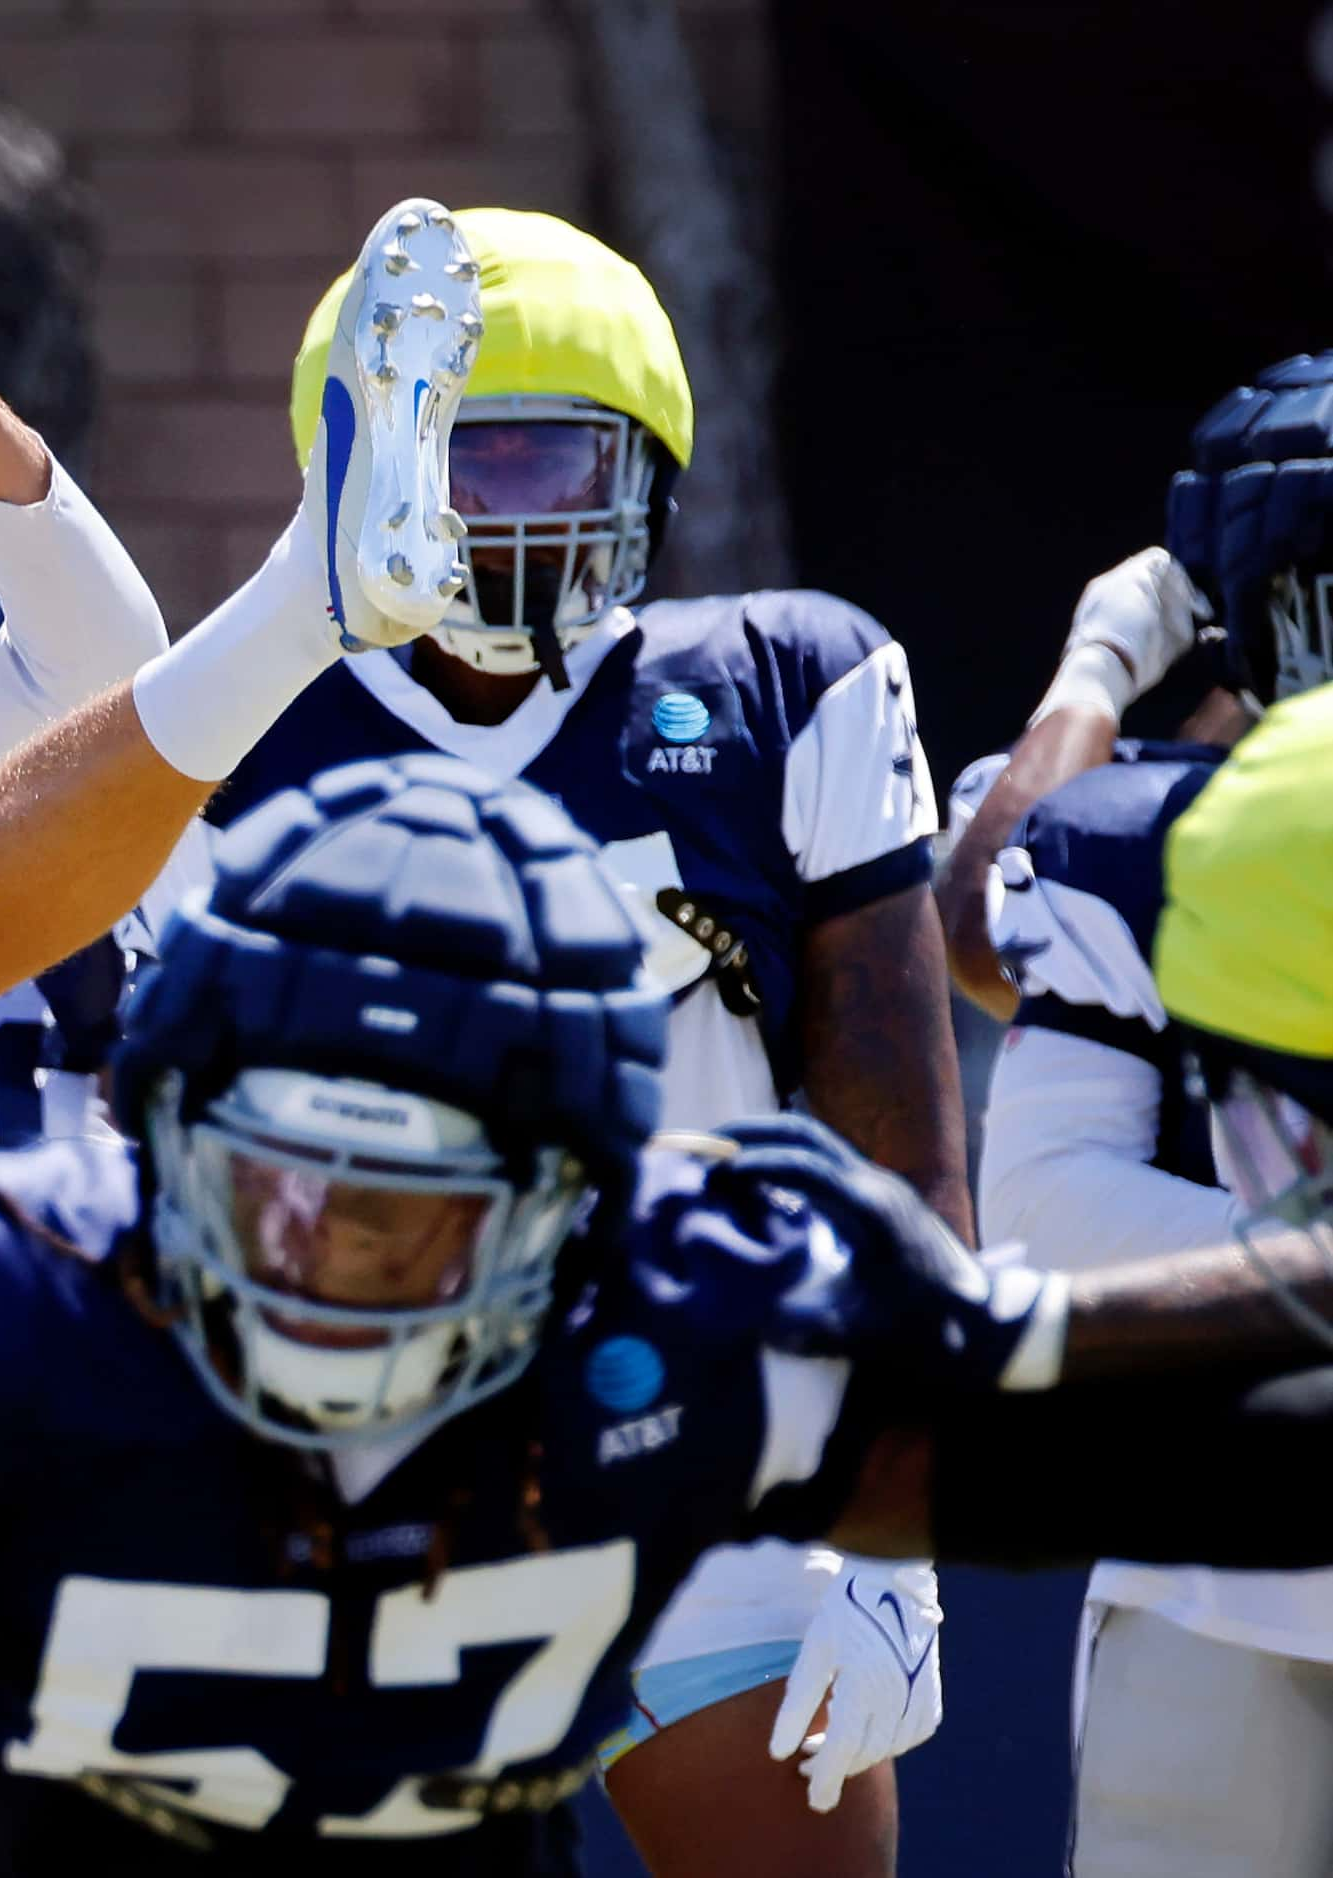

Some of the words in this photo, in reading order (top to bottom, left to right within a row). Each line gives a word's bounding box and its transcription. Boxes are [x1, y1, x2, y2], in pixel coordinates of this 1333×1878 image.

[647, 745, 718, 774] AT&T
[598, 1405, 684, 1464] AT&T
[4, 1538, 636, 1838] 57
